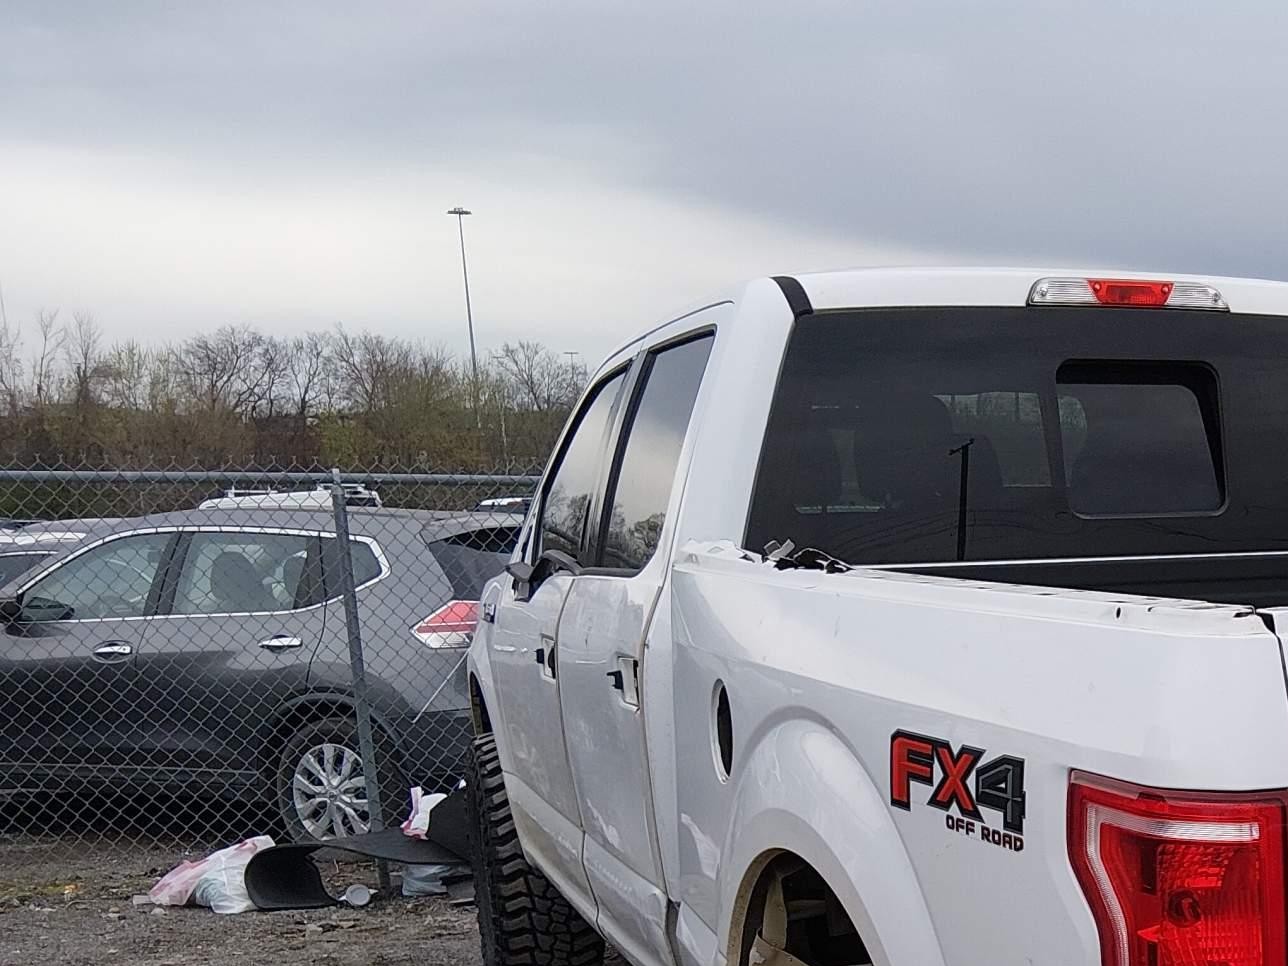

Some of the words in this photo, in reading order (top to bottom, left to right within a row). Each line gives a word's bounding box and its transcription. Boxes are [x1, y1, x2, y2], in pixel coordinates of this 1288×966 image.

[890, 728, 1026, 835] FX4
[946, 815, 975, 835] OFF
[981, 825, 1023, 852] ROAD
